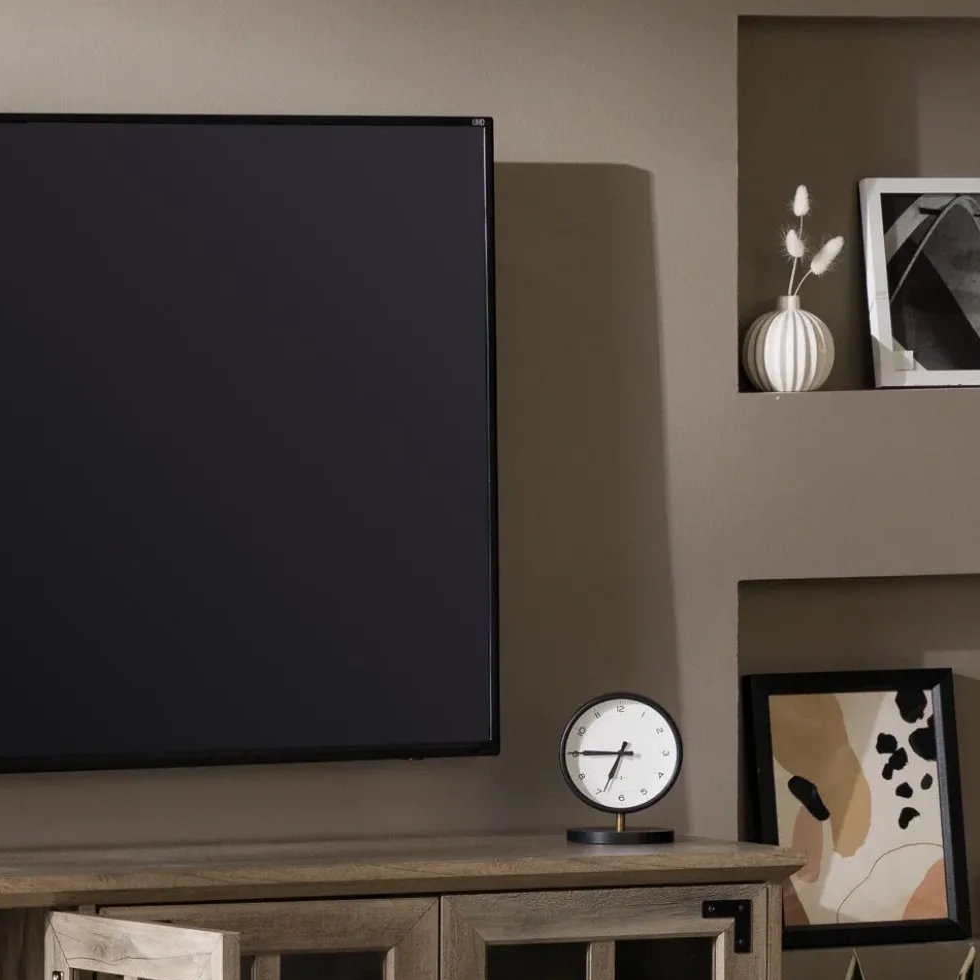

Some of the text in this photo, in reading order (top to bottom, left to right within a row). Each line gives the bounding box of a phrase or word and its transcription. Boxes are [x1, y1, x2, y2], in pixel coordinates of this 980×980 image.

[616, 705, 625, 713] 12
[576, 726, 586, 737] 10
[656, 727, 664, 735] 2
[662, 749, 670, 757] 3
[658, 771, 664, 780] 4
[595, 787, 603, 795] 7
[618, 794, 626, 802] 6
